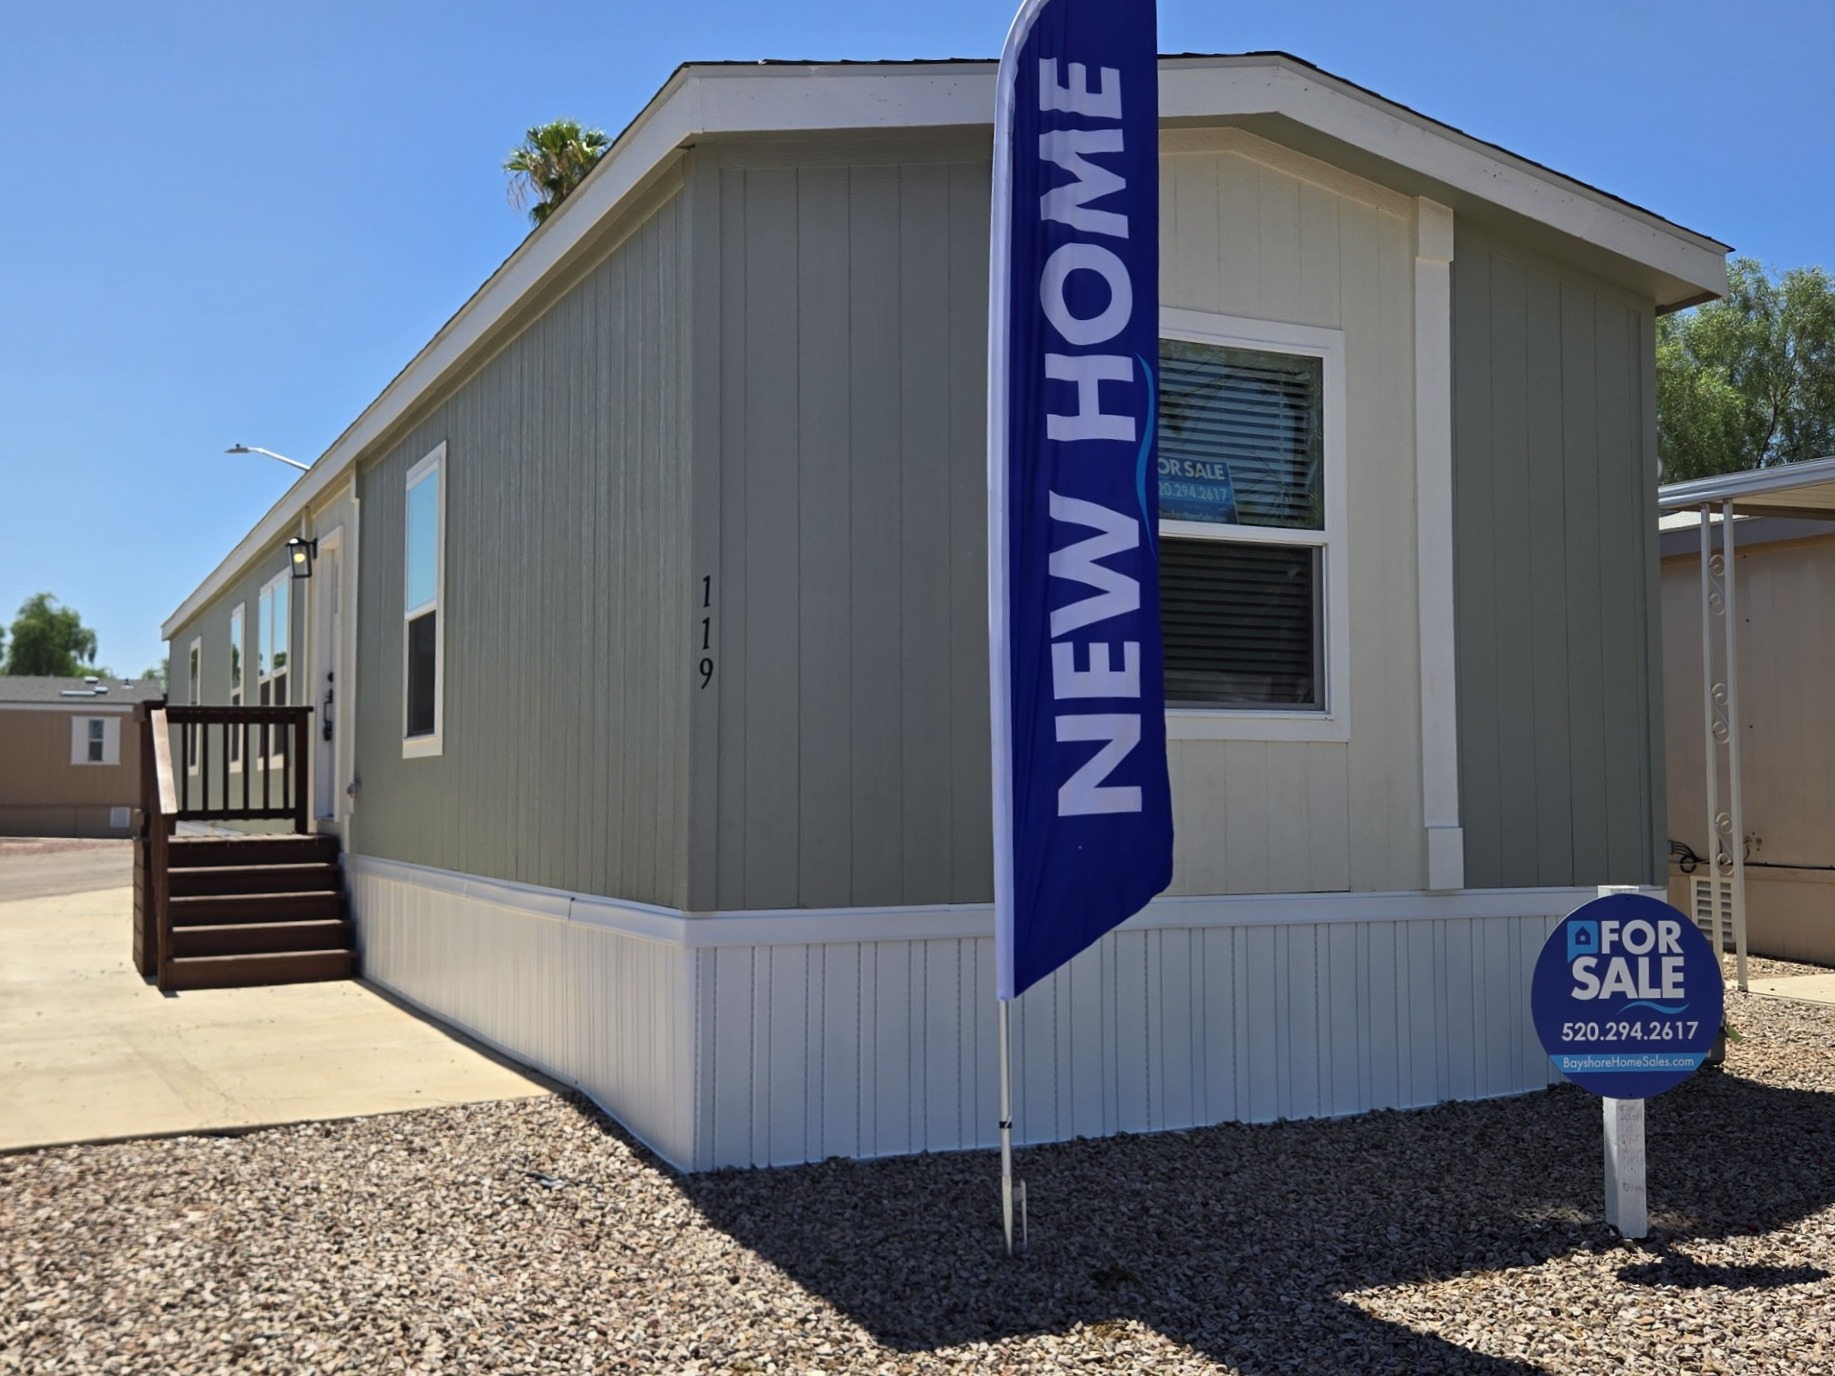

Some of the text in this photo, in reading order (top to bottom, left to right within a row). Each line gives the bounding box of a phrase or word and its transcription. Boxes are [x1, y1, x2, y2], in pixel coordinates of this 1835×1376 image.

[1039, 58, 1143, 816] NEW HOME
[1158, 457, 1225, 480] OR SALE
[699, 574, 714, 690] 119
[1601, 919, 1684, 955] FOR
[1571, 956, 1685, 1001] SALE
[1561, 1021, 1699, 1041] 520.294.2617
[1563, 1056, 1694, 1071] BayshoreHomeSales.com
